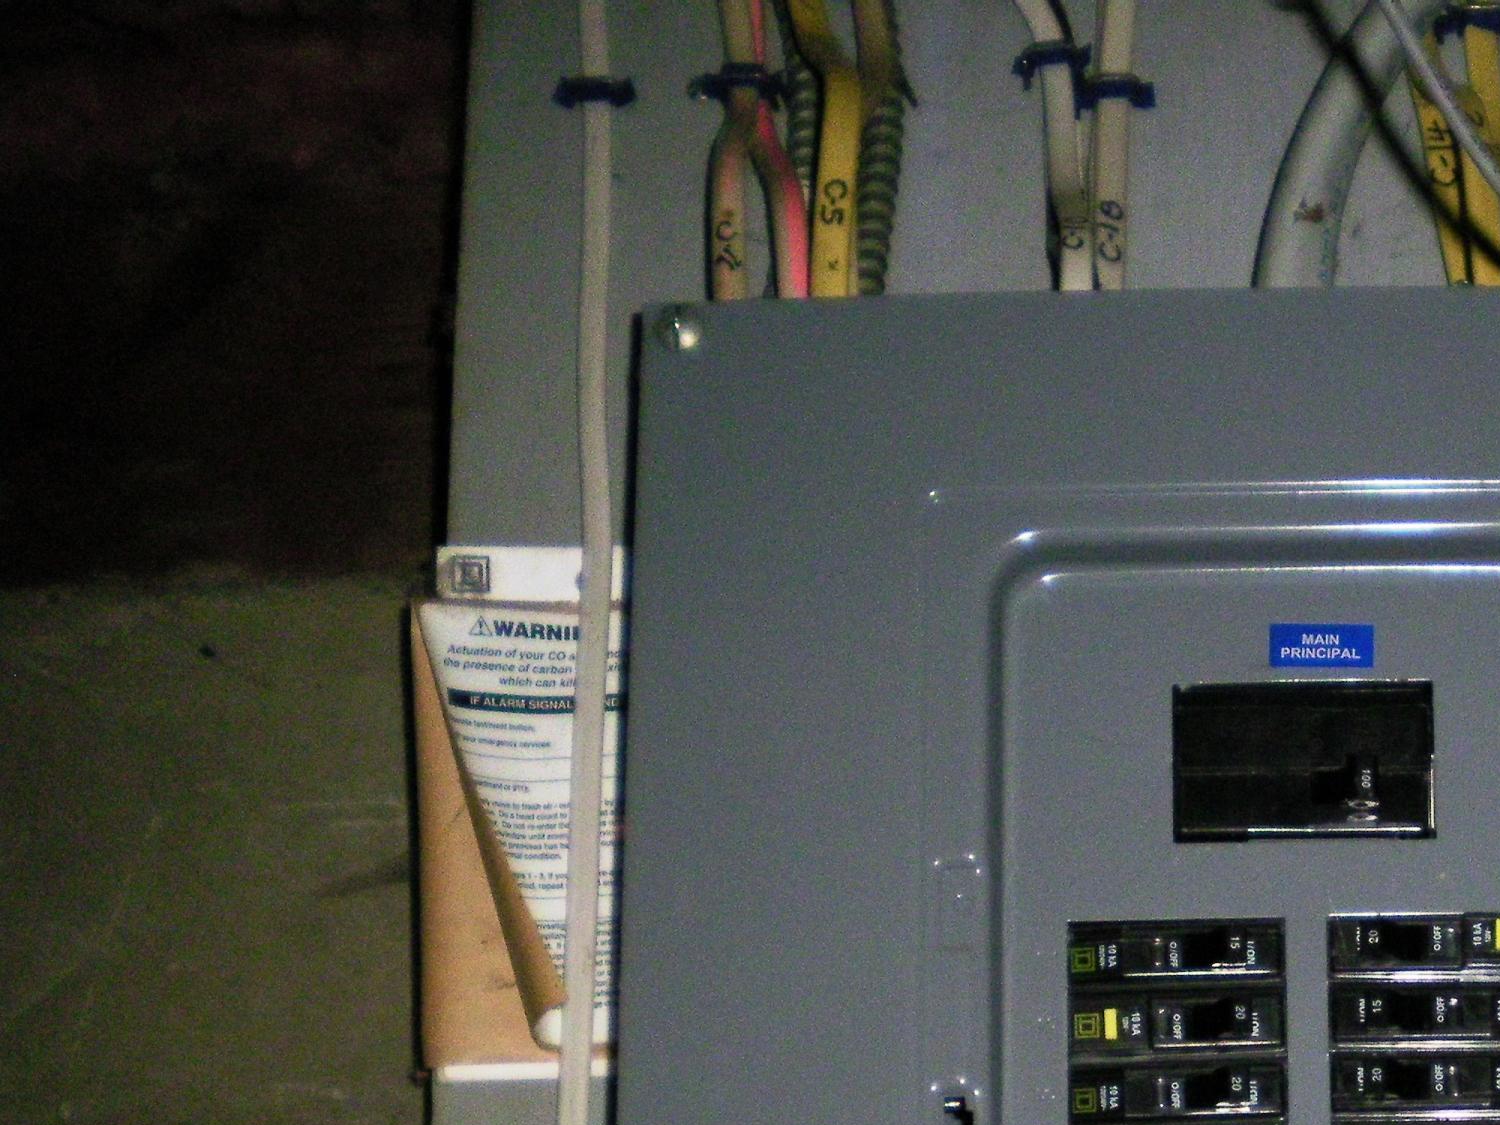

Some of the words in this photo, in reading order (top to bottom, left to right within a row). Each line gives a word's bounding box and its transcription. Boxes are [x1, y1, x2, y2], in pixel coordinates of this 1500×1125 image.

[820, 179, 848, 225] C-5
[494, 620, 579, 641] WARNI
[1302, 633, 1340, 645] MAIN
[448, 645, 502, 659] Actuation
[505, 649, 517, 659] of
[519, 650, 545, 663] your
[548, 651, 566, 661] CO
[1280, 646, 1361, 660] PRINCIPAL
[499, 677, 532, 688] which
[535, 679, 556, 688] can
[470, 696, 480, 705] IF
[483, 698, 526, 709] ALARM
[529, 701, 573, 710] SIGNAL
[1361, 769, 1371, 788] 100
[1229, 936, 1240, 950] 15
[1368, 930, 1380, 945] 20
[1234, 1005, 1246, 1020] 20
[1371, 999, 1382, 1013] 15
[1372, 1067, 1383, 1082] 20
[1230, 1076, 1243, 1092] 20
